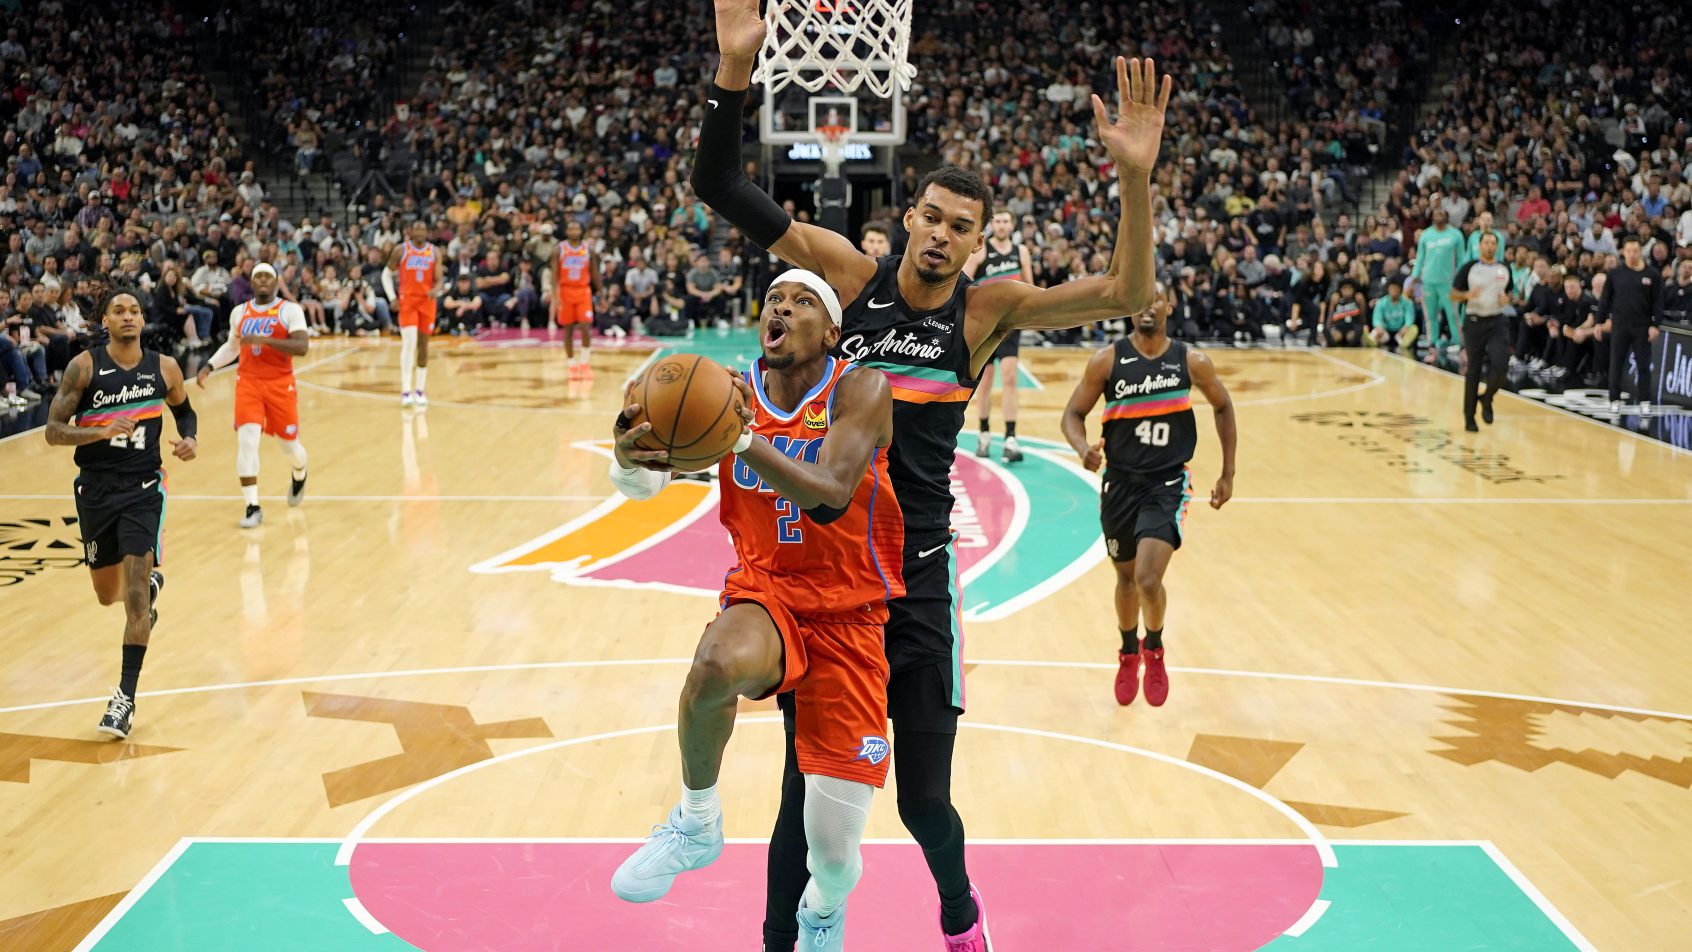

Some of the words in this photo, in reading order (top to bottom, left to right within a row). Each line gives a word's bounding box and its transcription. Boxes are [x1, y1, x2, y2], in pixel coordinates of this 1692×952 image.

[241, 317, 277, 337] OKC
[872, 329, 945, 360] Antonio
[93, 389, 115, 408] San
[116, 383, 155, 403] Antonio
[1115, 379, 1137, 399] San
[1138, 374, 1181, 395] Antonio
[1135, 420, 1170, 447] 40
[776, 496, 803, 544] 2
